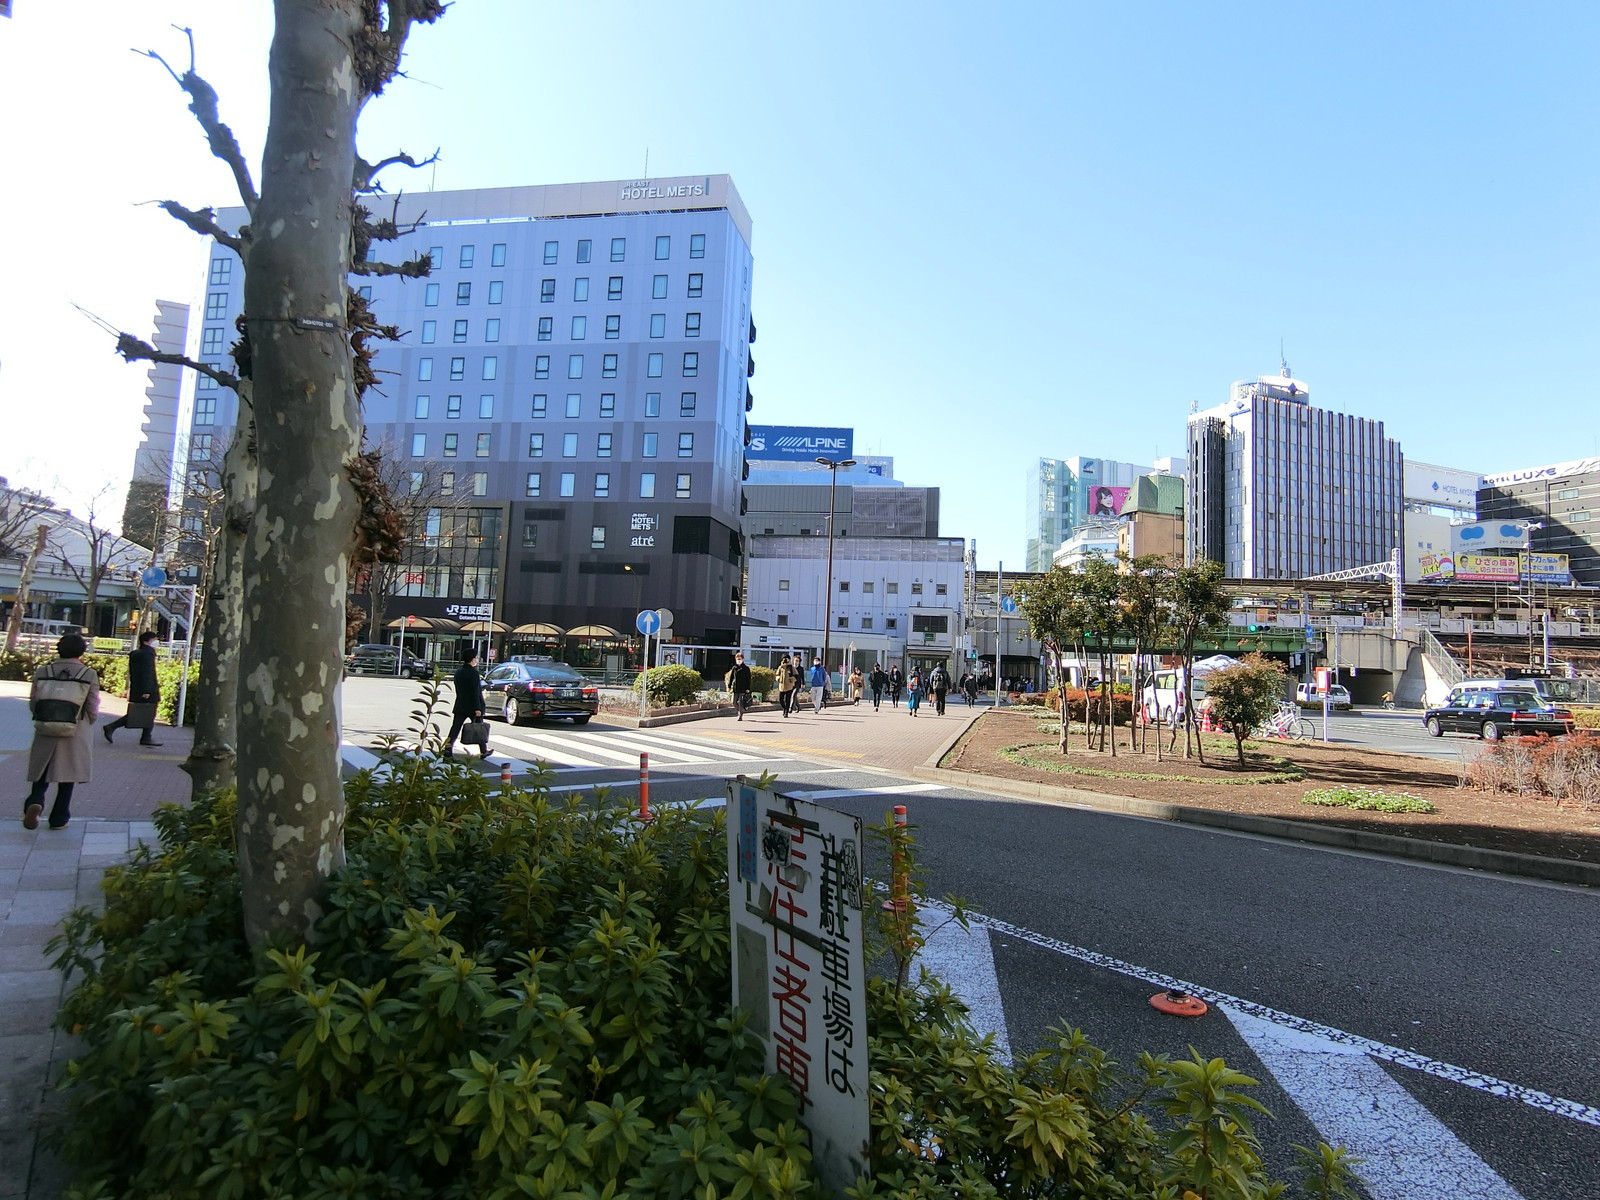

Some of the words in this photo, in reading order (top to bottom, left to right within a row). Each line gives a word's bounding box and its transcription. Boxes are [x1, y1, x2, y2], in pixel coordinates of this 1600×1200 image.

[621, 188, 665, 200] HOTEL
[667, 184, 703, 198] METS
[781, 436, 846, 449] ALPINE
[1483, 477, 1510, 485] HOTEL
[1514, 467, 1557, 481] LUXE
[1442, 485, 1459, 494] HOTEL
[631, 523, 651, 531] METS
[631, 535, 655, 546] atré
[446, 604, 460, 613] JR
[767, 815, 813, 1150] 居住者専
